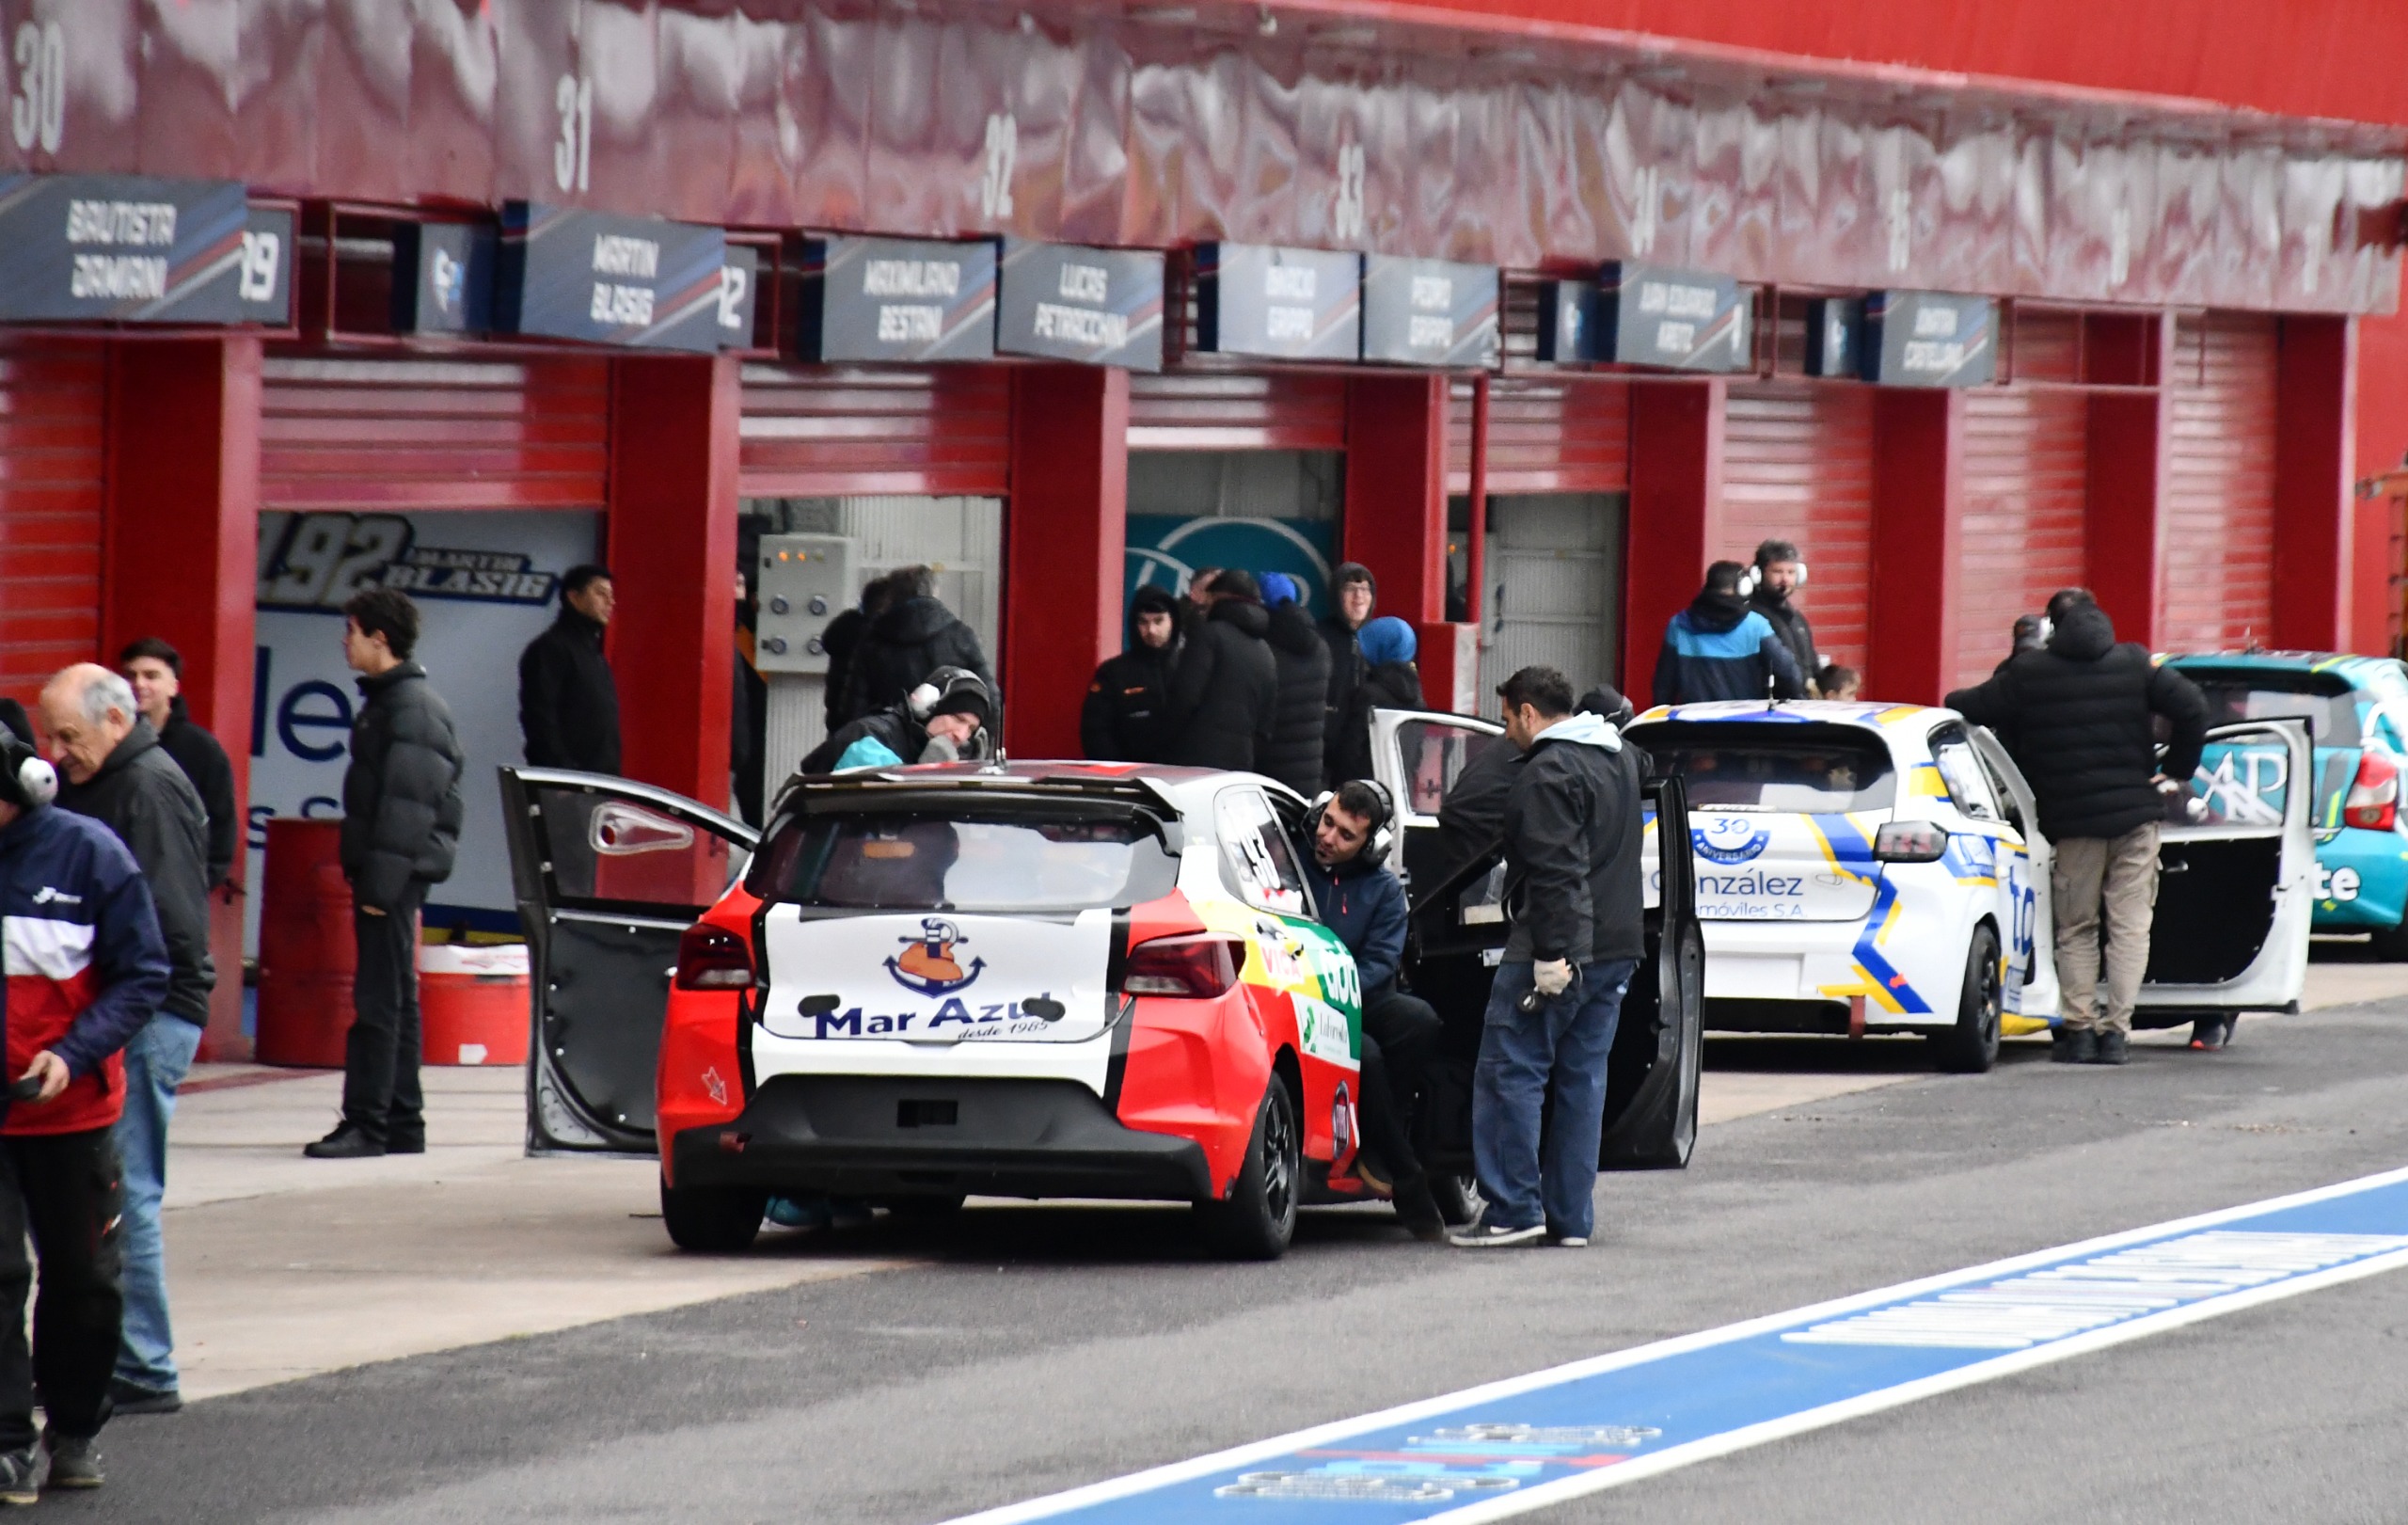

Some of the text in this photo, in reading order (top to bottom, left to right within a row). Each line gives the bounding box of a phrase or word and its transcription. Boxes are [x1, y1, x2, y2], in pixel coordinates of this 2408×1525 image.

[12, 20, 64, 155] 30
[554, 73, 592, 192] 31
[1710, 818, 1750, 834] 30
[1651, 867, 1804, 896] nzález
[1695, 901, 1768, 918] móviles
[815, 1006, 916, 1040] Mar
[958, 1018, 1049, 1040] desde 1985
